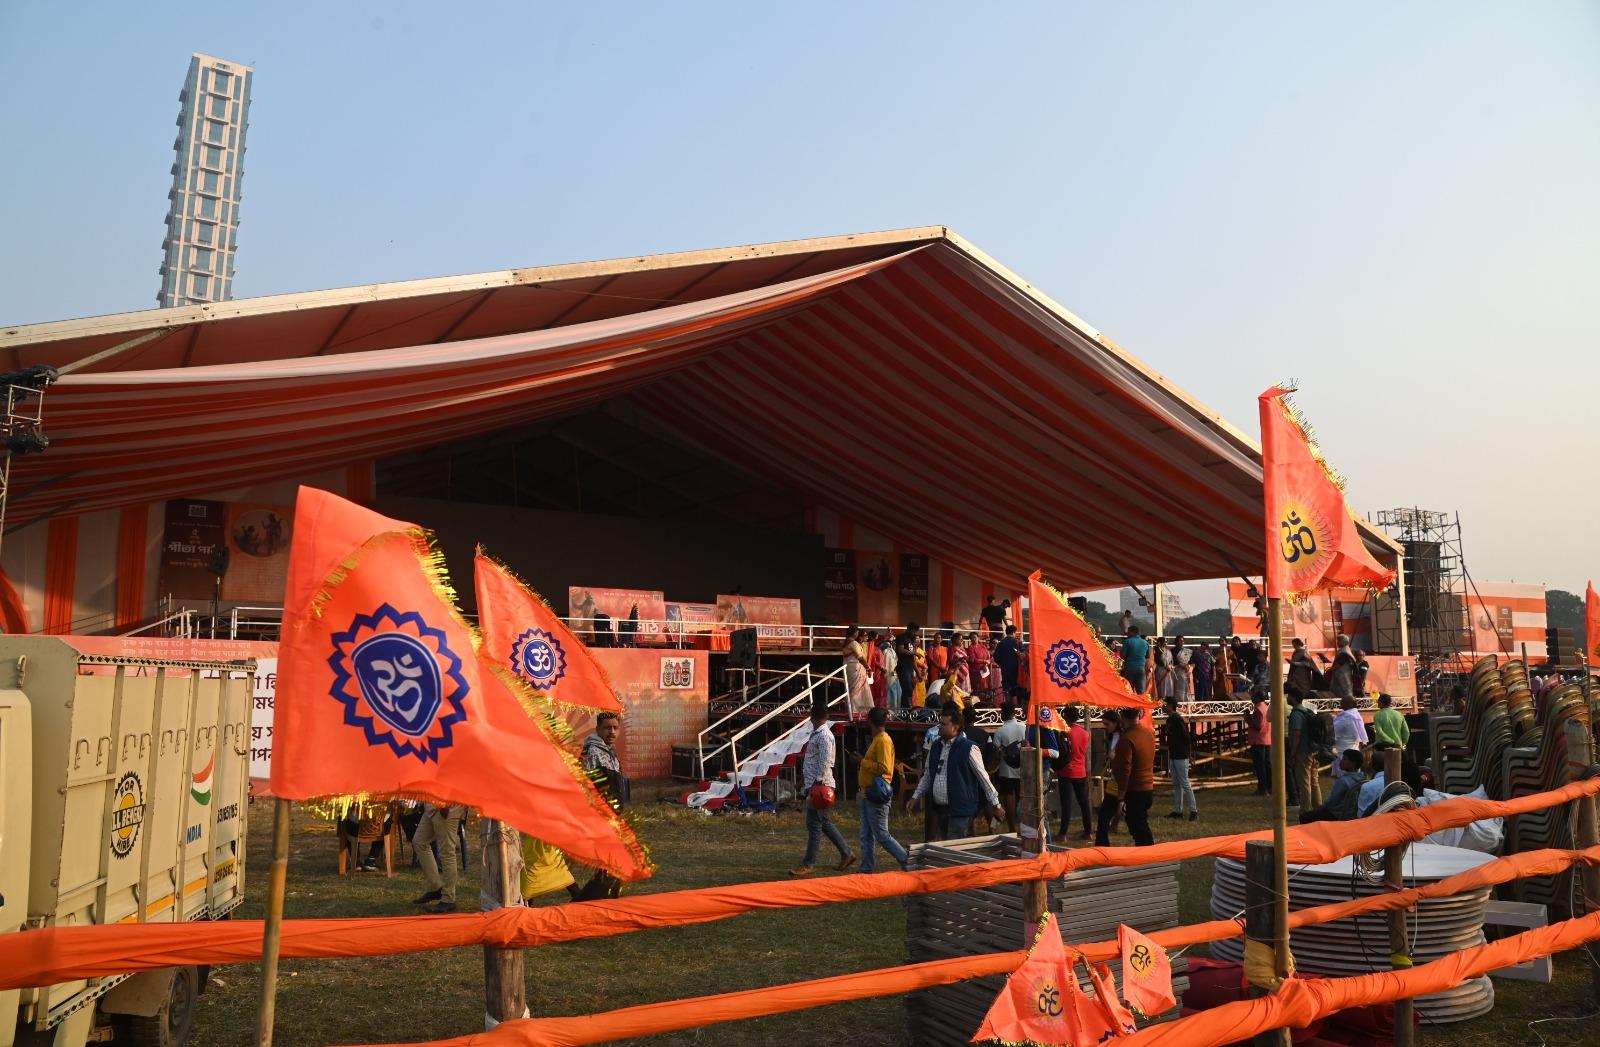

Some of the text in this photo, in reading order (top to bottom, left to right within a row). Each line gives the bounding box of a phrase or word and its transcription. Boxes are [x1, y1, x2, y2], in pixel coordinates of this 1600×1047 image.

[120, 780, 135, 796] FOR
[186, 823, 202, 844] NDIA
[116, 838, 131, 851] HIRE
